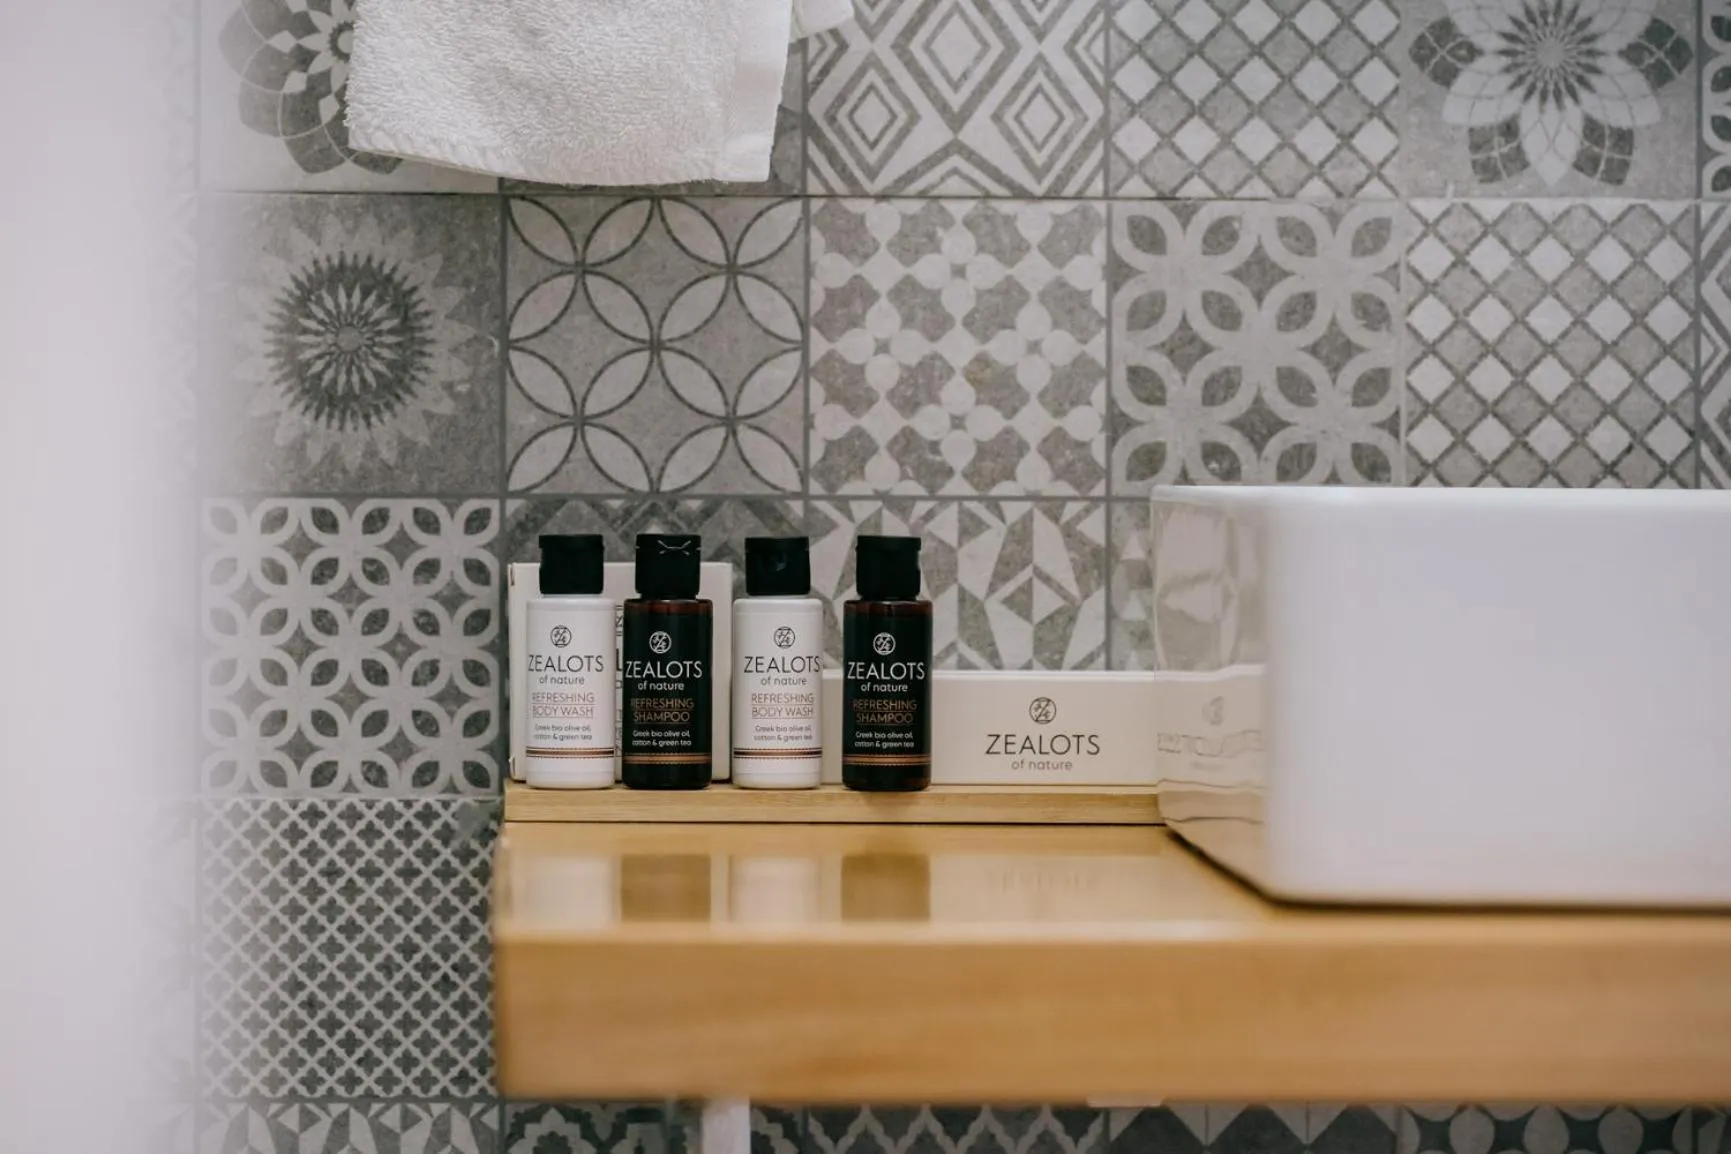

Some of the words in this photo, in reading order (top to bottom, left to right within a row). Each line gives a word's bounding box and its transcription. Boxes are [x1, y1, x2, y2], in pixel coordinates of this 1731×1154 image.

[528, 655, 604, 672] ZEALOTS
[744, 656, 820, 673] ZEALOTS
[625, 661, 703, 678] ZEALOTS
[847, 662, 925, 680] ZEALOTS
[539, 675, 548, 684] of
[550, 676, 585, 685] nature
[638, 681, 648, 690] of
[650, 682, 684, 690] nature
[760, 676, 770, 685] of
[774, 677, 807, 685] nature
[861, 682, 870, 692] of
[873, 683, 908, 692] nature
[532, 692, 595, 702] REFRESHING
[751, 693, 814, 703] REFRESHING
[631, 698, 694, 709] REFRESHING
[853, 699, 917, 711] REFRESHING
[533, 706, 557, 716] BODY
[561, 706, 593, 716] WASH
[633, 711, 690, 722] SHAMPOO
[751, 707, 783, 717] BODY
[785, 707, 813, 717] WASH
[857, 713, 913, 724] SHAMPOO
[985, 733, 1100, 756] ZEALOTS
[1011, 759, 1025, 770] of
[1028, 760, 1072, 770] nature
